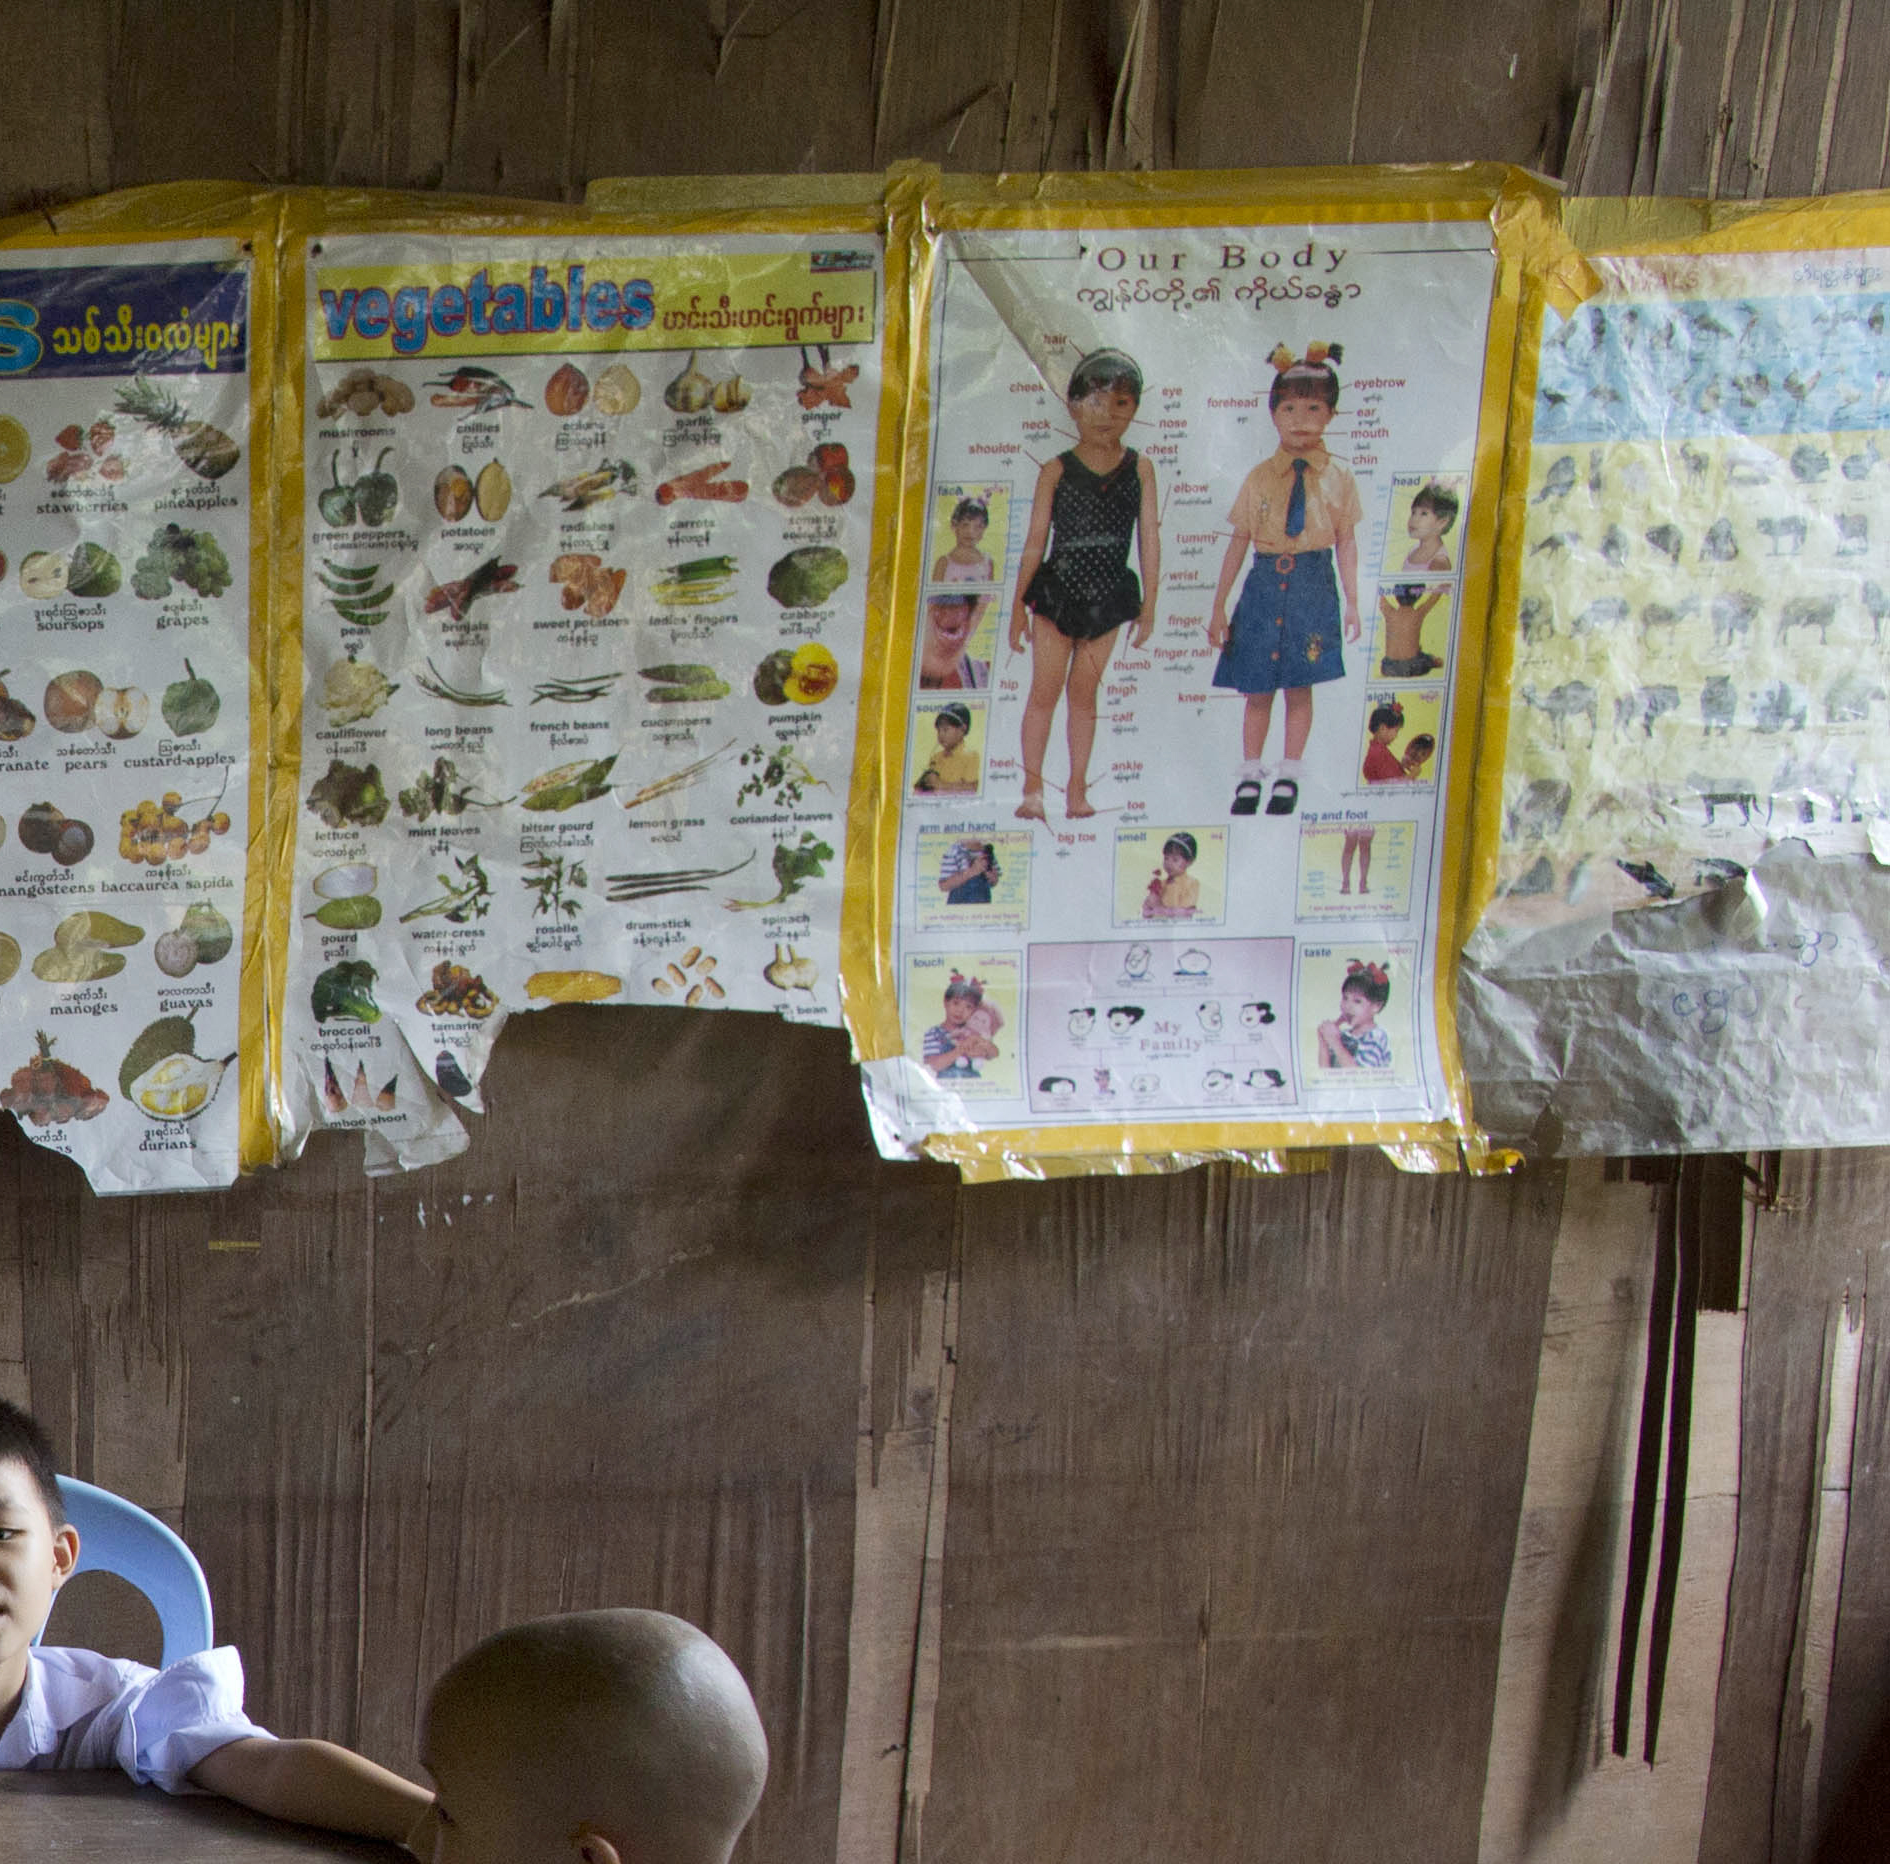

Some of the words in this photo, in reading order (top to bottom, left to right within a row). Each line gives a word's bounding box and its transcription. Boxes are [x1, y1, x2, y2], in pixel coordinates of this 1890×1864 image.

[1096, 246, 1188, 272] Our
[1220, 241, 1348, 274] Body
[319, 265, 657, 355] vegetables
[1042, 333, 1068, 346] hair
[1009, 380, 1045, 394] cheek
[1353, 377, 1407, 391] eyebrow
[1161, 387, 1184, 398] eye
[1206, 396, 1260, 409] forehead
[800, 410, 844, 425] ginger
[1356, 407, 1377, 418] ear
[456, 422, 500, 435] chillies
[675, 416, 715, 430] garlic
[1021, 419, 1052, 431] neck
[1158, 417, 1188, 429] nose
[319, 426, 397, 440] mushrooms
[1350, 427, 1390, 440] mouth
[968, 443, 1022, 456] shoulder
[1145, 443, 1179, 456] chest
[1351, 454, 1379, 466] chin
[1173, 482, 1209, 494] elbow
[1392, 475, 1421, 487] head
[154, 495, 238, 512] pineapples
[441, 525, 496, 539] potatoes
[1176, 532, 1220, 546] tummy
[36, 618, 105, 633] soursops
[155, 613, 210, 630] grapes
[442, 620, 490, 635] brinjals
[532, 618, 570, 631] sweet
[1167, 614, 1204, 628] finger
[340, 625, 372, 639] peas
[1153, 647, 1189, 661] finger
[1191, 647, 1214, 658] nail
[1112, 659, 1152, 672] thumb
[999, 678, 1020, 692] hip
[1106, 684, 1138, 698] thigh
[1177, 692, 1207, 704] knee
[768, 711, 823, 727] pumpkin
[1111, 711, 1135, 723] calf
[424, 725, 452, 739] long
[455, 723, 494, 736] beans
[529, 720, 570, 732] french
[572, 719, 611, 731] beans
[315, 726, 388, 741] cauliflower
[64, 757, 108, 774] pears
[123, 751, 237, 769] custard-apples
[989, 757, 1015, 769] heel
[1110, 760, 1144, 773] ankle
[1126, 800, 1147, 811] toe
[628, 818, 668, 830] lemon
[670, 816, 706, 830] grass
[729, 813, 790, 826] coriander
[792, 811, 834, 823] leaves
[1300, 810, 1318, 823] leg
[1321, 810, 1343, 821] and
[1345, 809, 1369, 821] foot
[407, 825, 437, 838] mint
[439, 824, 482, 837] leaves
[558, 821, 594, 835] gourd
[918, 822, 941, 834] arm
[943, 821, 966, 834] and
[968, 821, 997, 833] hand
[314, 829, 360, 842] lettuce
[1056, 832, 1076, 845] big
[1077, 832, 1097, 843] toe
[101, 878, 180, 894] baccaurea
[185, 875, 235, 892] sapida
[625, 917, 692, 932] drum-stick
[761, 912, 811, 927] spinach
[411, 927, 486, 940] water-cress
[535, 923, 579, 936] roselle
[321, 931, 359, 947] gourd
[1303, 947, 1332, 958] taste
[912, 957, 945, 969] touch
[50, 1000, 119, 1017] manoges
[159, 996, 214, 1013] guavas
[796, 1005, 828, 1016] bean
[318, 1024, 372, 1038] broccoli
[1153, 1021, 1183, 1035] My
[1139, 1037, 1202, 1052] Family
[324, 1117, 367, 1129] mboo
[369, 1112, 408, 1126] shoot
[138, 1138, 198, 1152] durians
